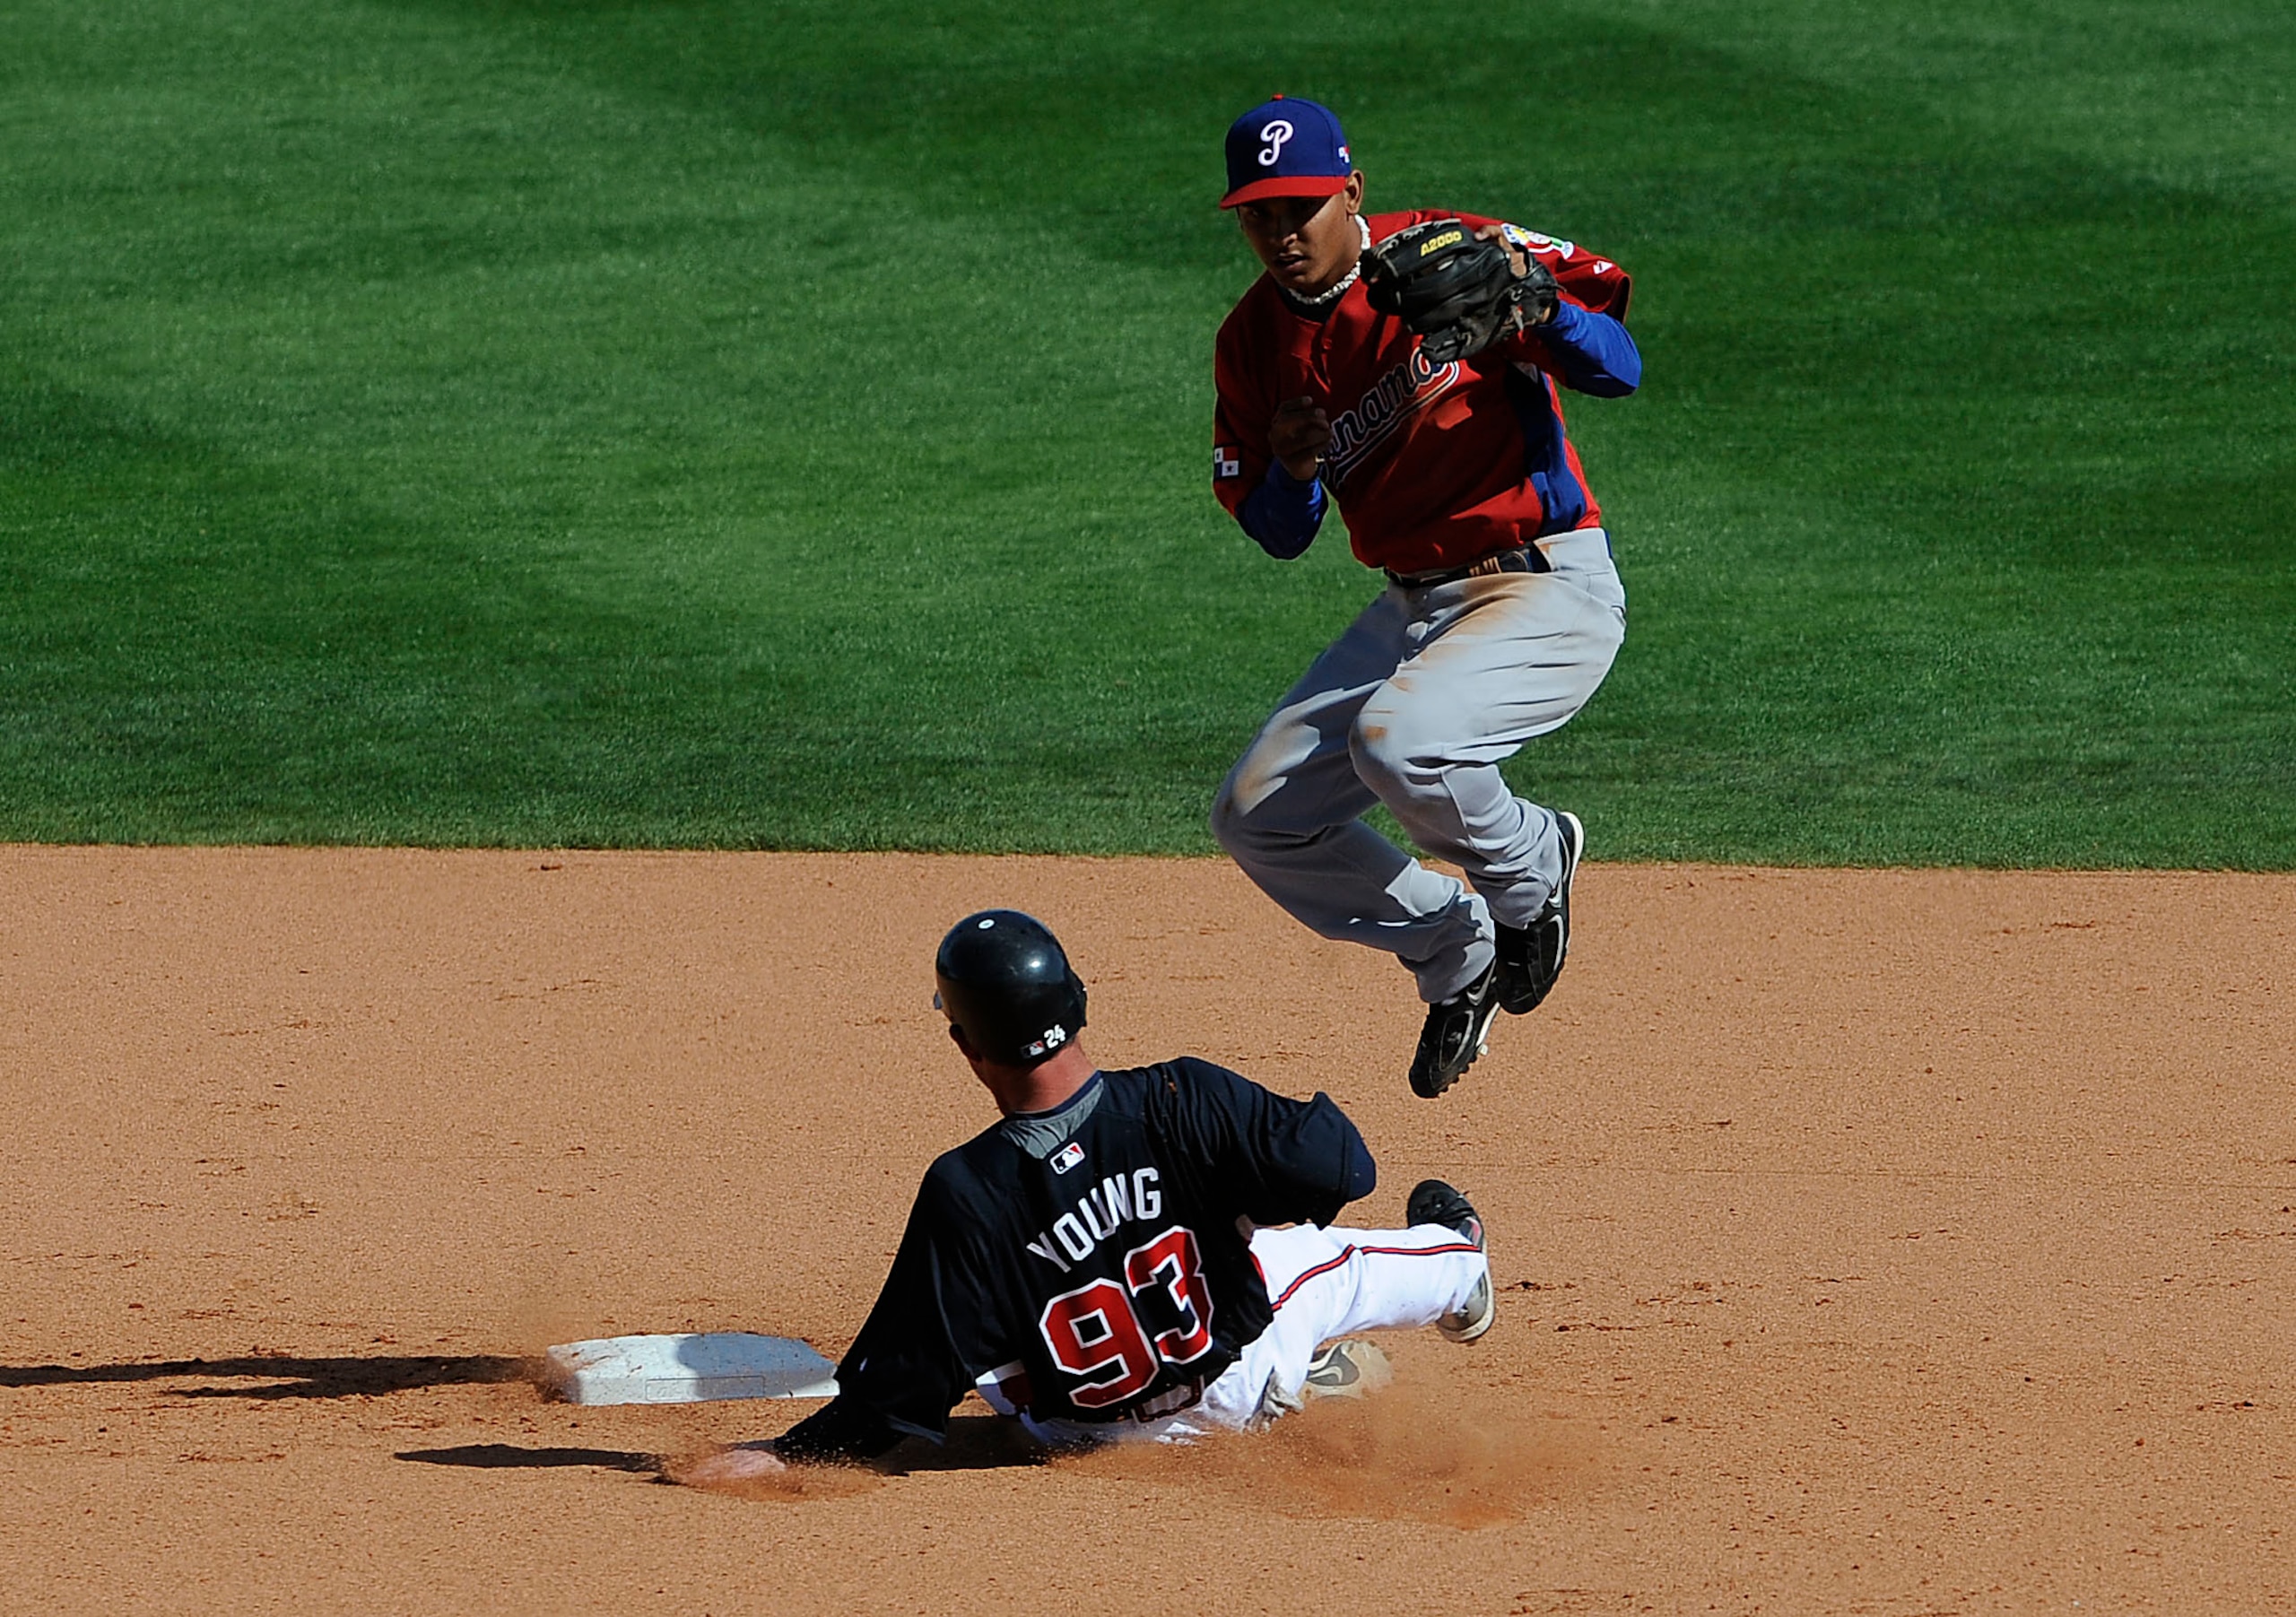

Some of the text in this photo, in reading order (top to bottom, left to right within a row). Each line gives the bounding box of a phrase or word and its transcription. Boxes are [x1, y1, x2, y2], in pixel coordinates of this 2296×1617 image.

[1257, 119, 1294, 166] P
[1420, 230, 1463, 257] A2000
[1318, 346, 1451, 482] nama
[1043, 1023, 1066, 1049] 24
[1026, 1167, 1161, 1274] YOUNG
[1039, 1225, 1214, 1408] 93
